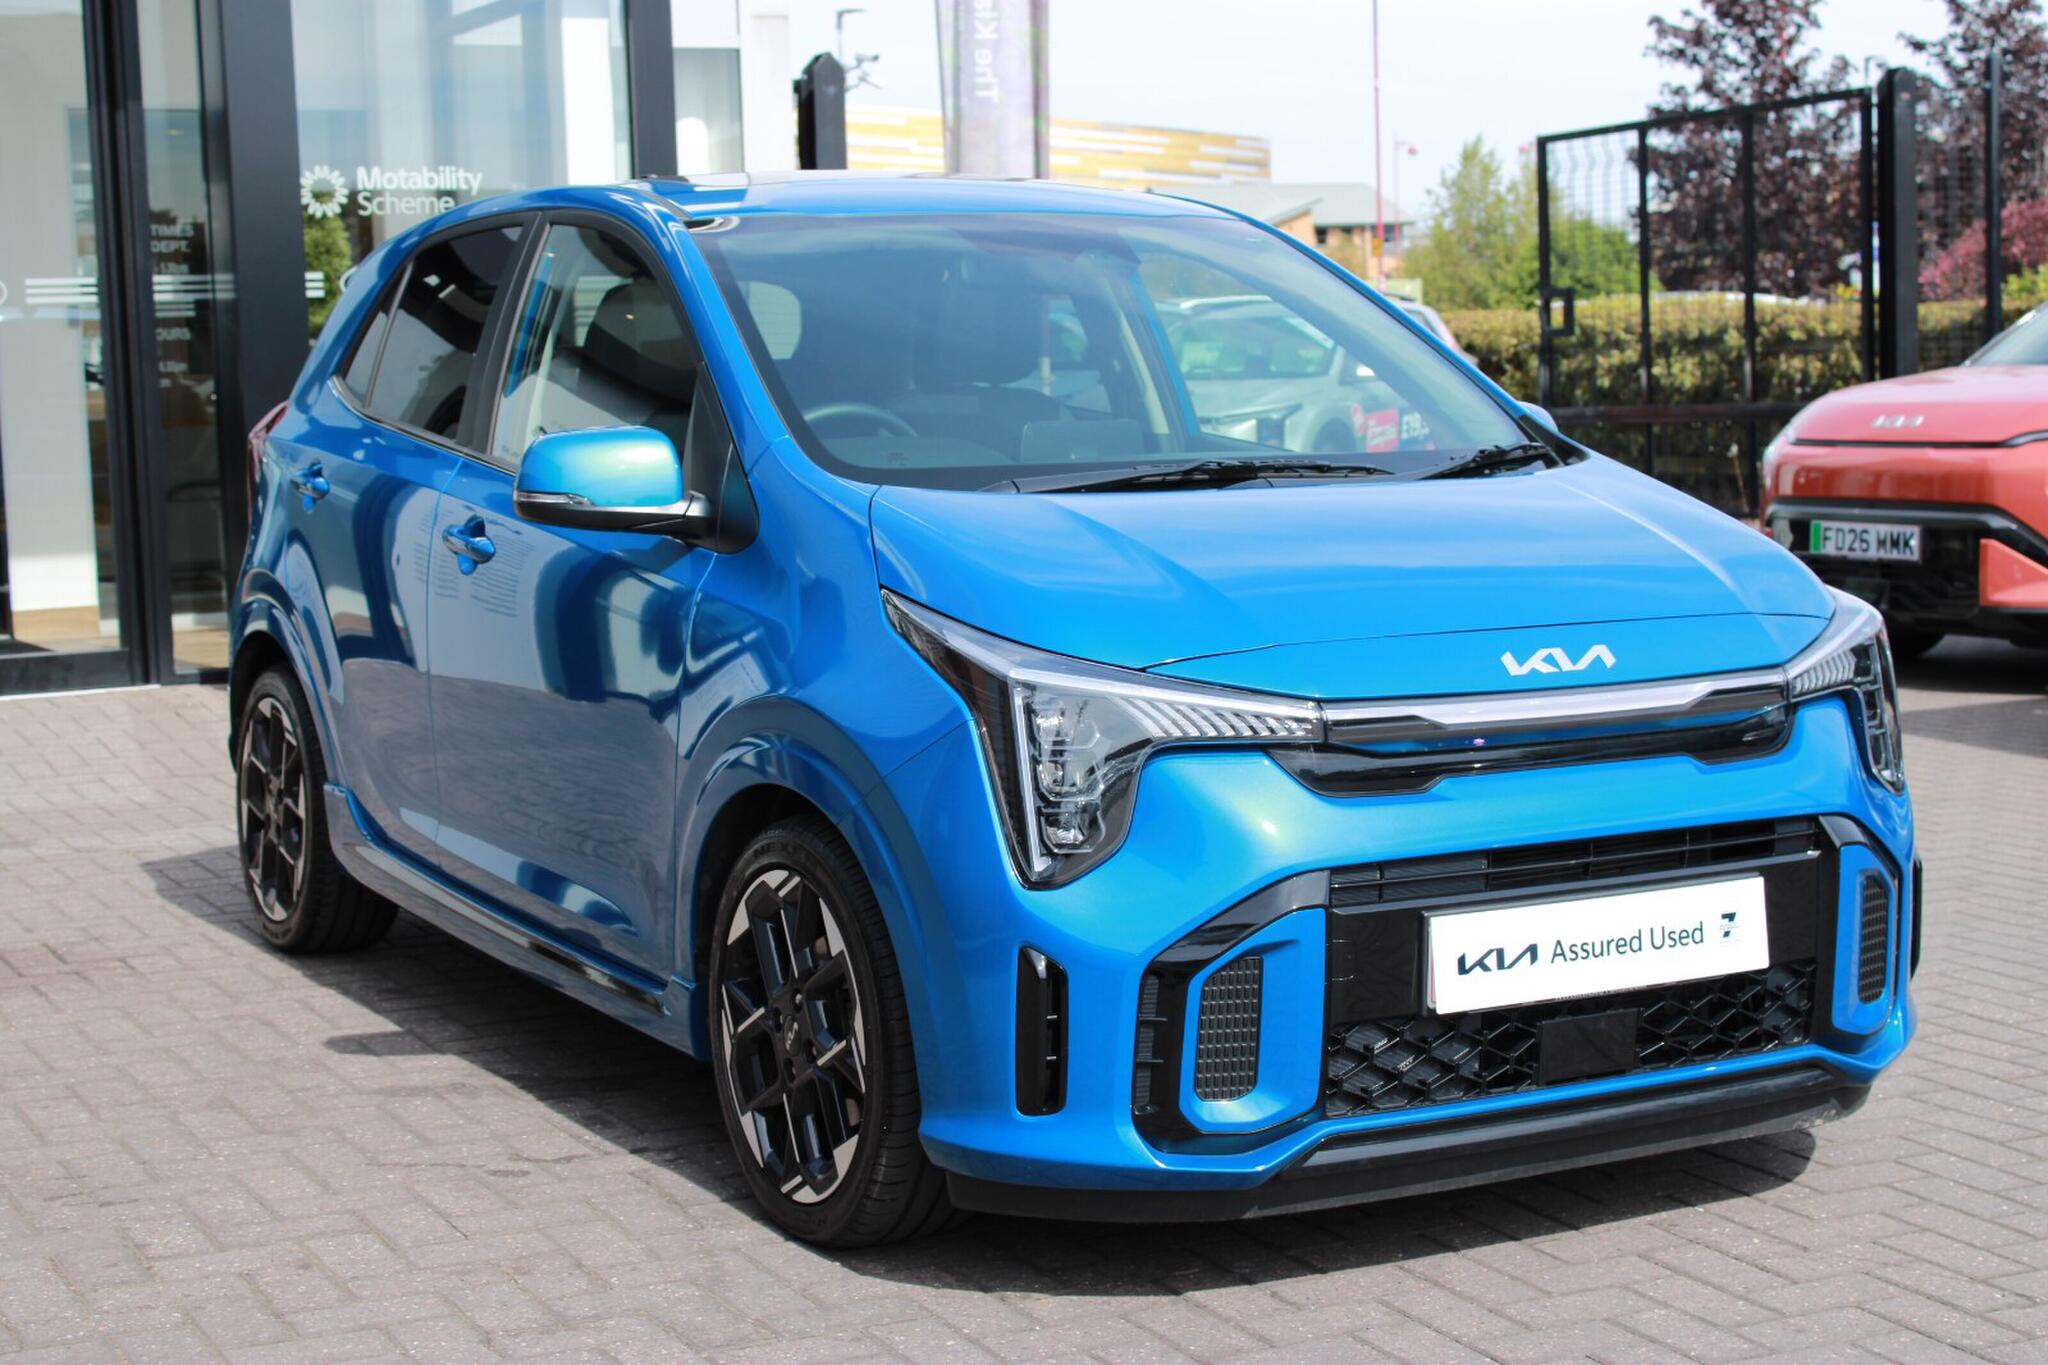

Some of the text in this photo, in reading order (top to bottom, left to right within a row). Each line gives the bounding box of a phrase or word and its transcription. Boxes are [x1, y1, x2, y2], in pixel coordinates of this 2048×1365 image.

[356, 165, 483, 196] Motability
[356, 191, 456, 217] Scheme
[1823, 527, 1870, 553] FD26
[1500, 644, 1616, 676] KIA
[1457, 943, 1539, 976] KIA
[1550, 929, 1643, 964] Assured
[1650, 921, 1704, 950] Used
